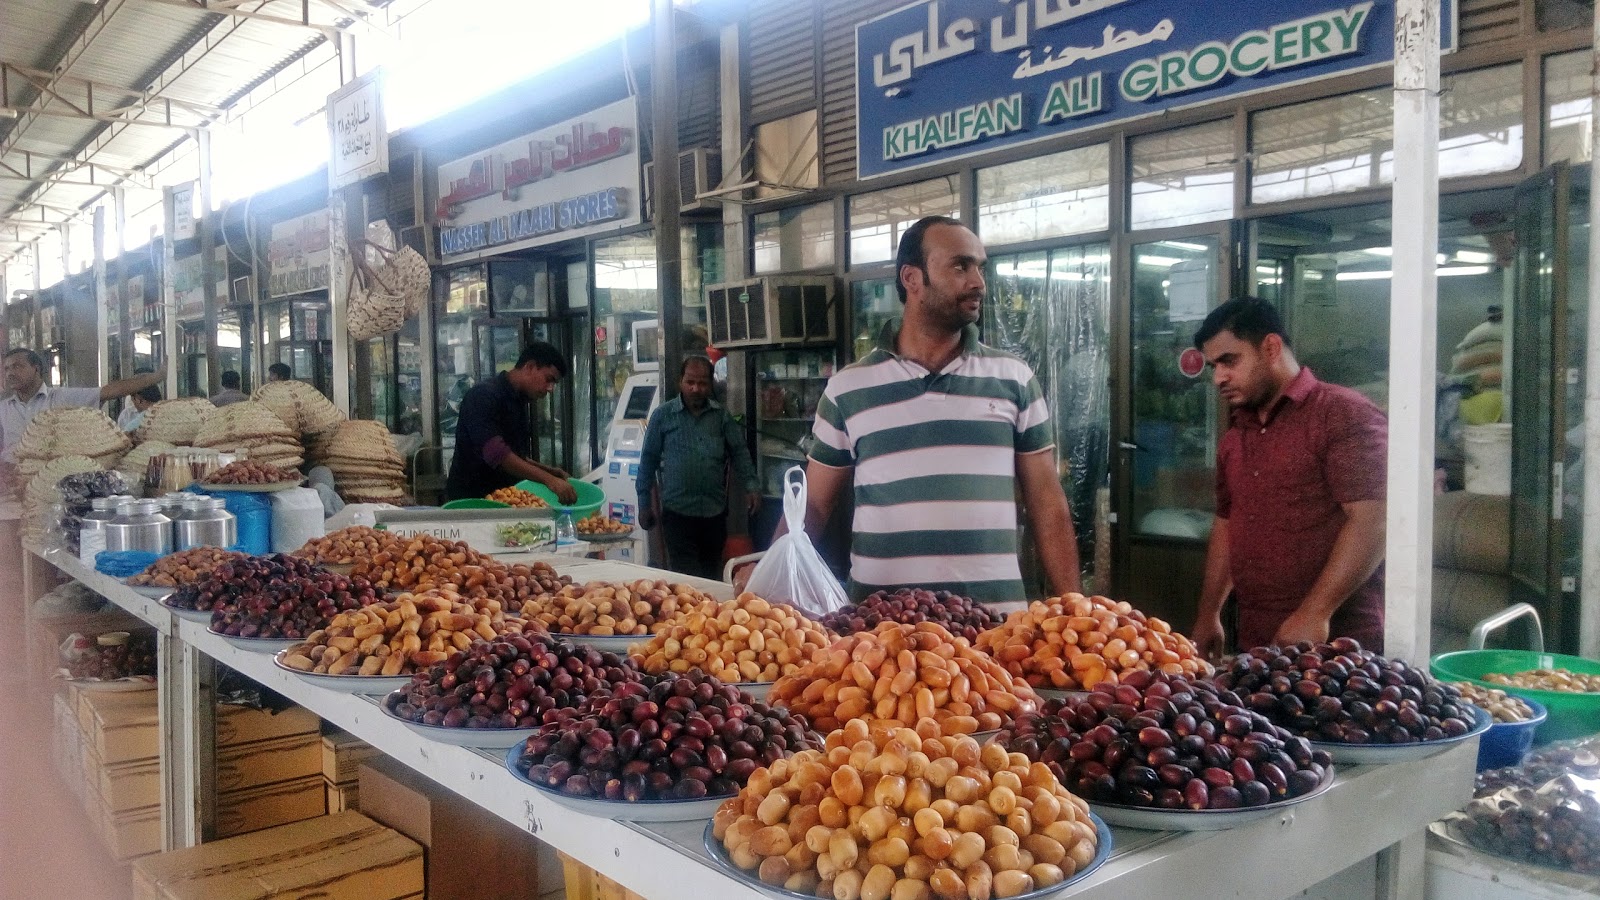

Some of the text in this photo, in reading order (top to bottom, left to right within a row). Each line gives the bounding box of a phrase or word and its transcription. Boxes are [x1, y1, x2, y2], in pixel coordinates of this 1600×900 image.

[873, 0, 975, 98] علي
[884, 2, 1374, 160] KHALFAN ALI GROCERY
[1012, 19, 1175, 79] مطحنة
[440, 186, 619, 255] NASSER AL KAABI STORES
[433, 528, 460, 539] FILM
